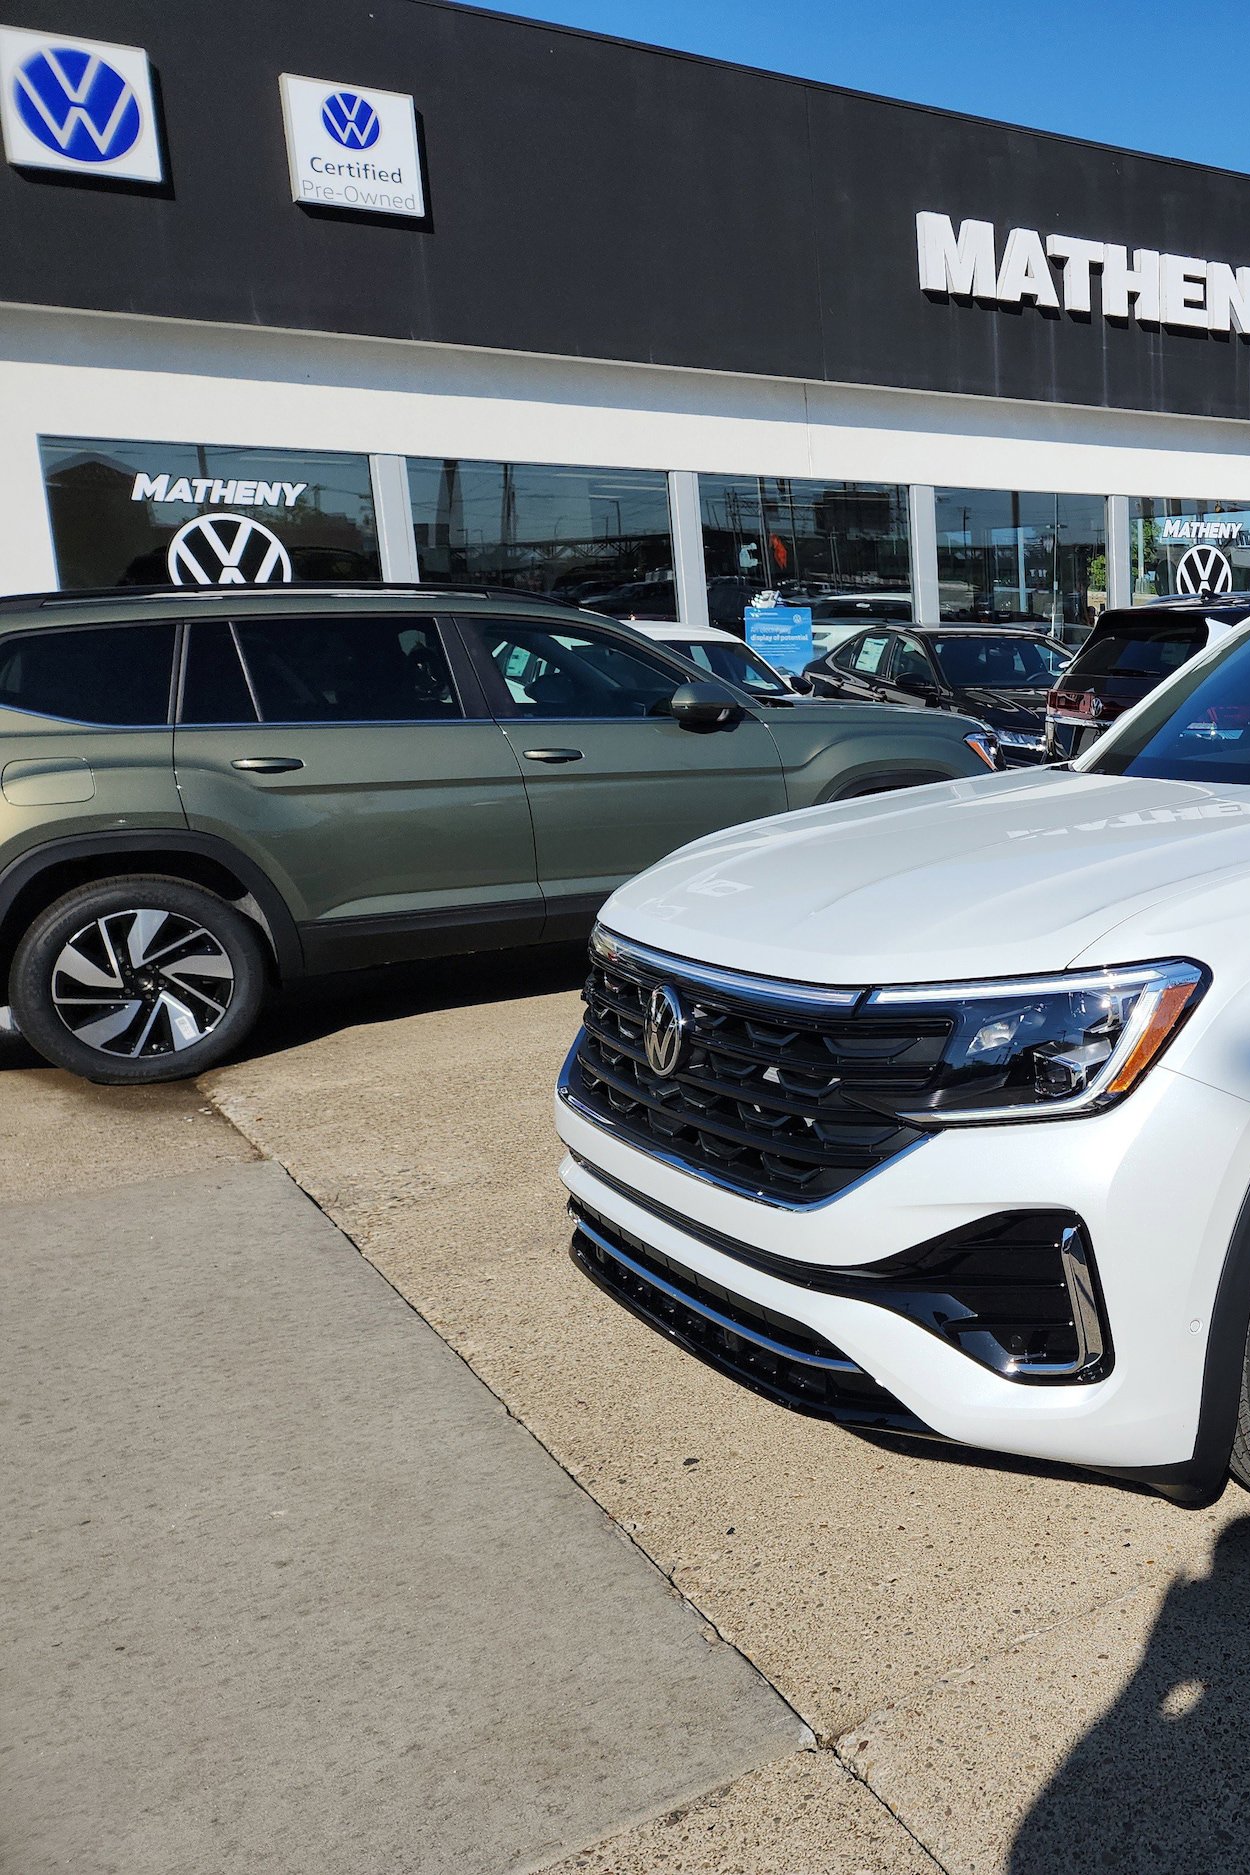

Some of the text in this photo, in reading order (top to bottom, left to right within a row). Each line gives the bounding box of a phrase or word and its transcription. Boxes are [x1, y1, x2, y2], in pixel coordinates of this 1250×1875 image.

[12, 47, 140, 160] VW
[322, 93, 380, 149] VW
[309, 156, 403, 184] Certified
[302, 179, 416, 210] Pre-Owned
[131, 472, 308, 507] MATHENY
[1162, 518, 1243, 539] MATHENY
